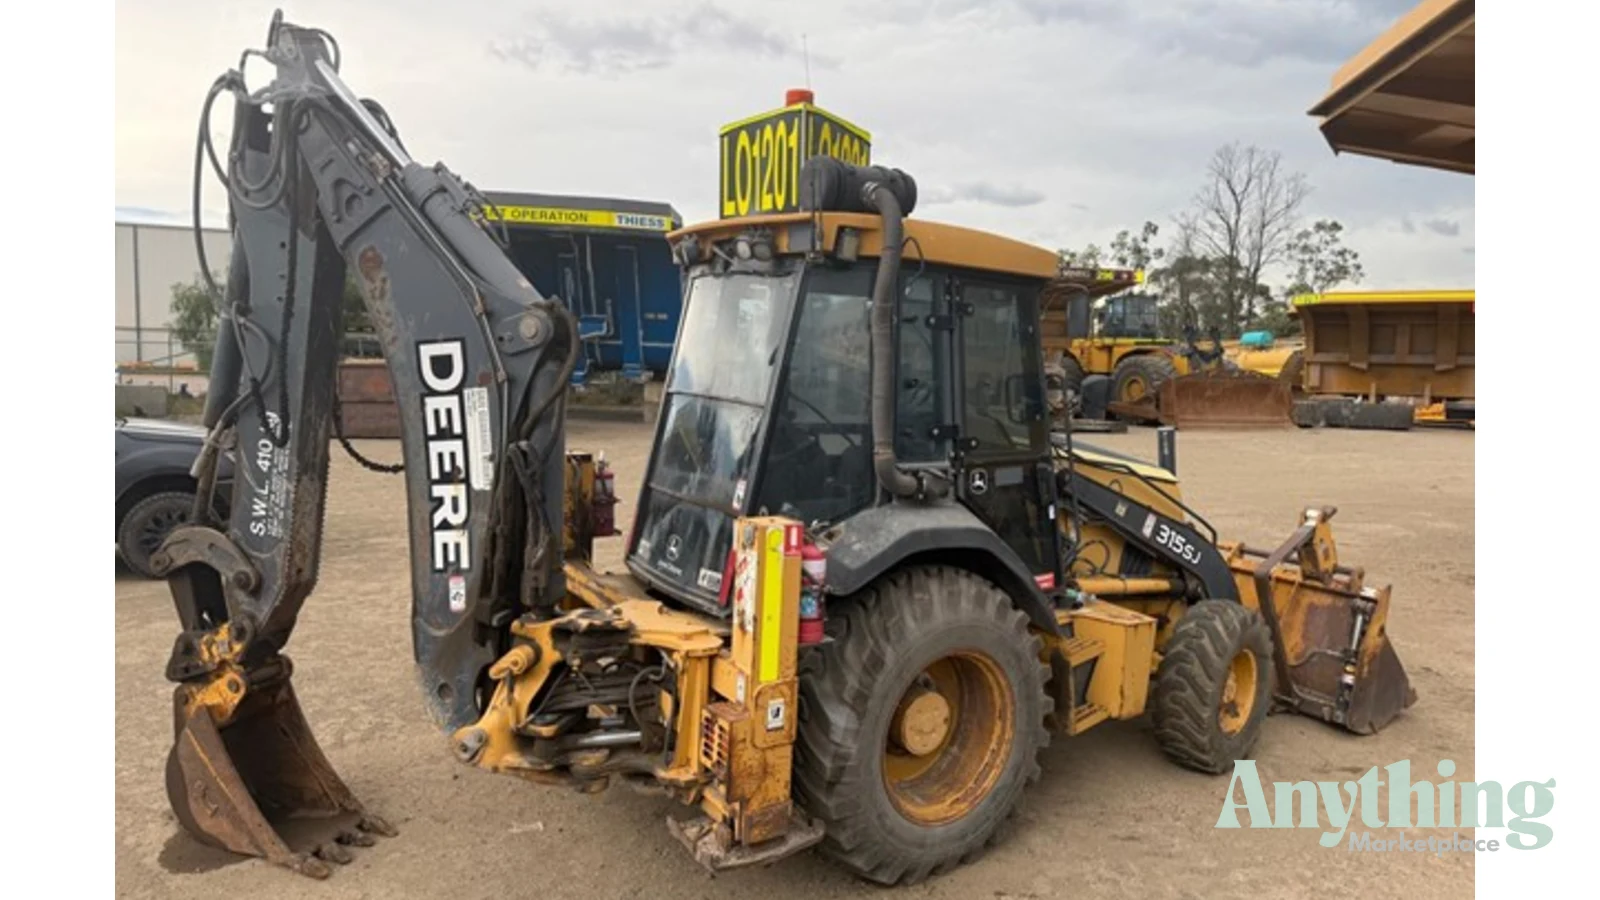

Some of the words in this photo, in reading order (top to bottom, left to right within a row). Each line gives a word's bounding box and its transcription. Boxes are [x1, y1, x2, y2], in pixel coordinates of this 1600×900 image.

[723, 116, 799, 216] LO1201
[510, 207, 589, 223] OPERATION
[616, 214, 666, 228] THIESS
[256, 438, 274, 473] 410
[418, 340, 471, 570] DEERE
[1155, 524, 1202, 565] 315SJ
